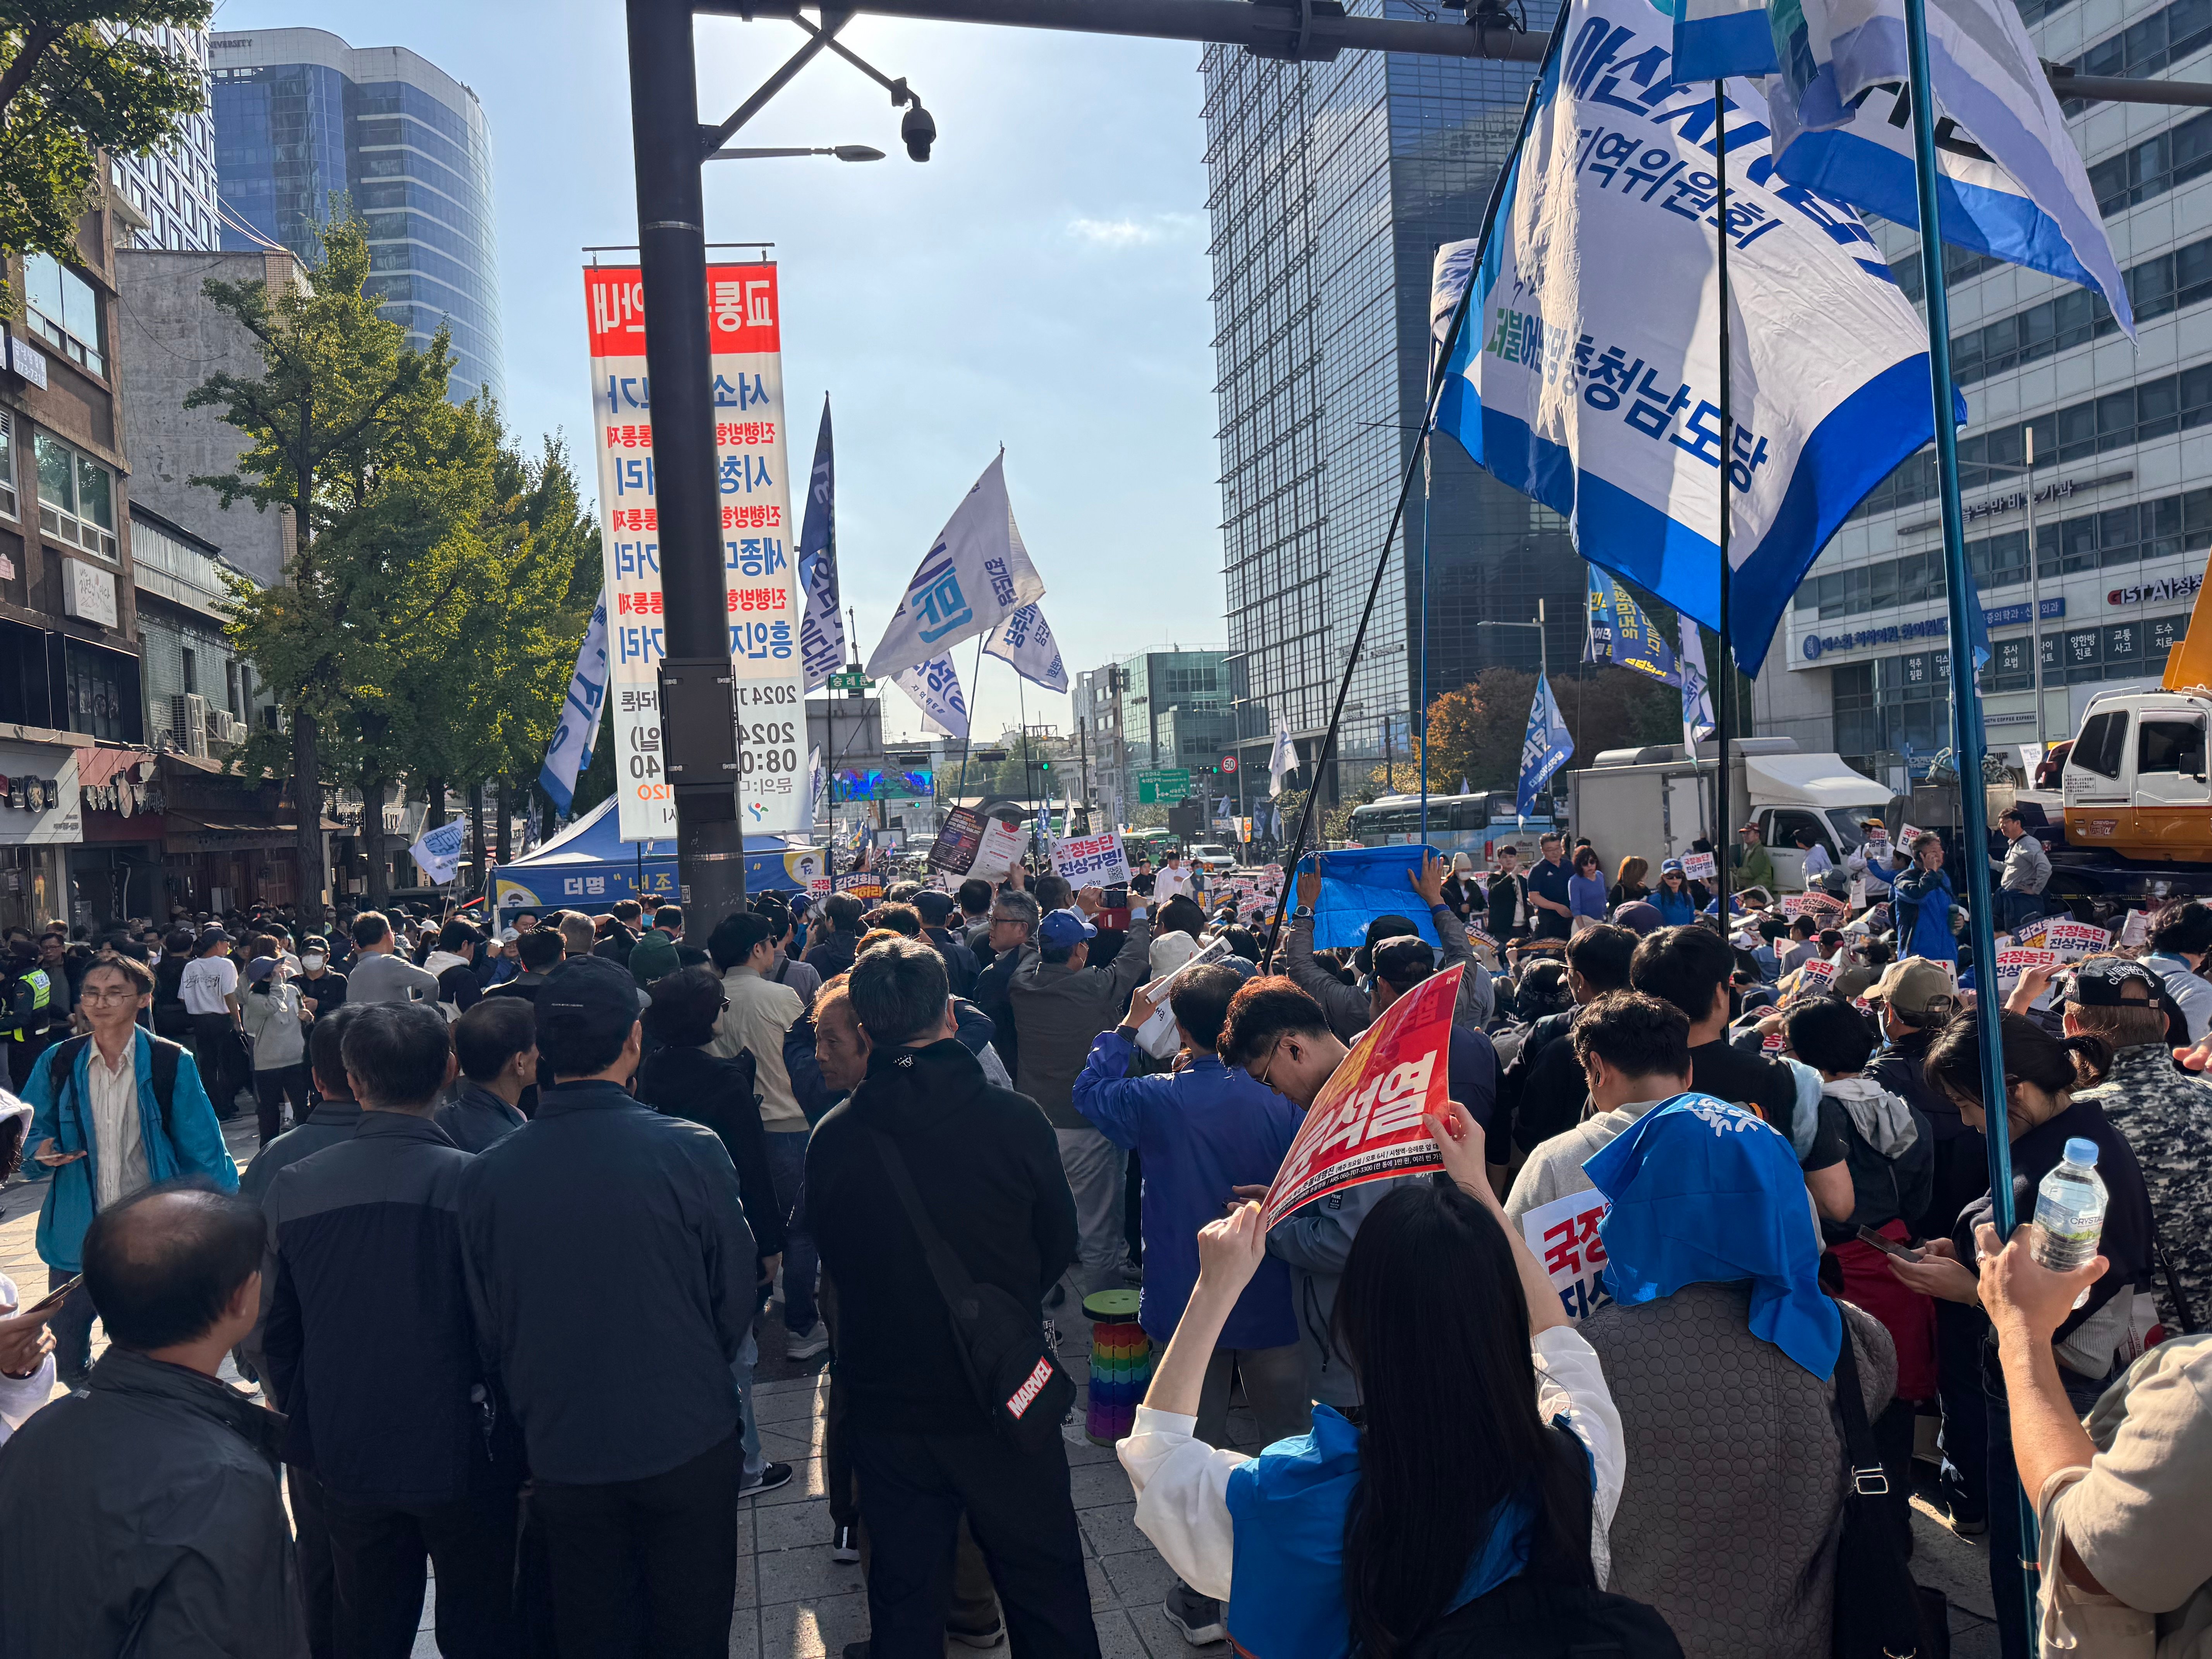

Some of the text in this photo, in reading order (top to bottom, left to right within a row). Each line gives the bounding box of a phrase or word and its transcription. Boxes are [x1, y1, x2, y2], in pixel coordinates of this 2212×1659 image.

[15, 359, 46, 386] 773-7318
[984, 557, 1019, 607] 경기도당
[2107, 584, 2150, 605] GIST
[2070, 634, 2095, 648] 양한방
[2114, 630, 2131, 640] 교통
[2003, 644, 2018, 655] 주사
[2075, 650, 2092, 660] 진료
[2114, 642, 2132, 654] 사고
[1909, 658, 1922, 667] 척추
[2003, 656, 2018, 668] 요법
[1909, 670, 1922, 680] 질환
[1225, 760, 1234, 769] 50
[1056, 834, 1115, 860] 국정농단
[1058, 848, 1123, 878] 진상규명!
[563, 876, 605, 895] 더명
[2052, 925, 2106, 941] 국정농단
[1996, 950, 2055, 965] 국정농단
[1996, 965, 2036, 978] 진상
[1007, 1360, 1051, 1416] MARVEL
